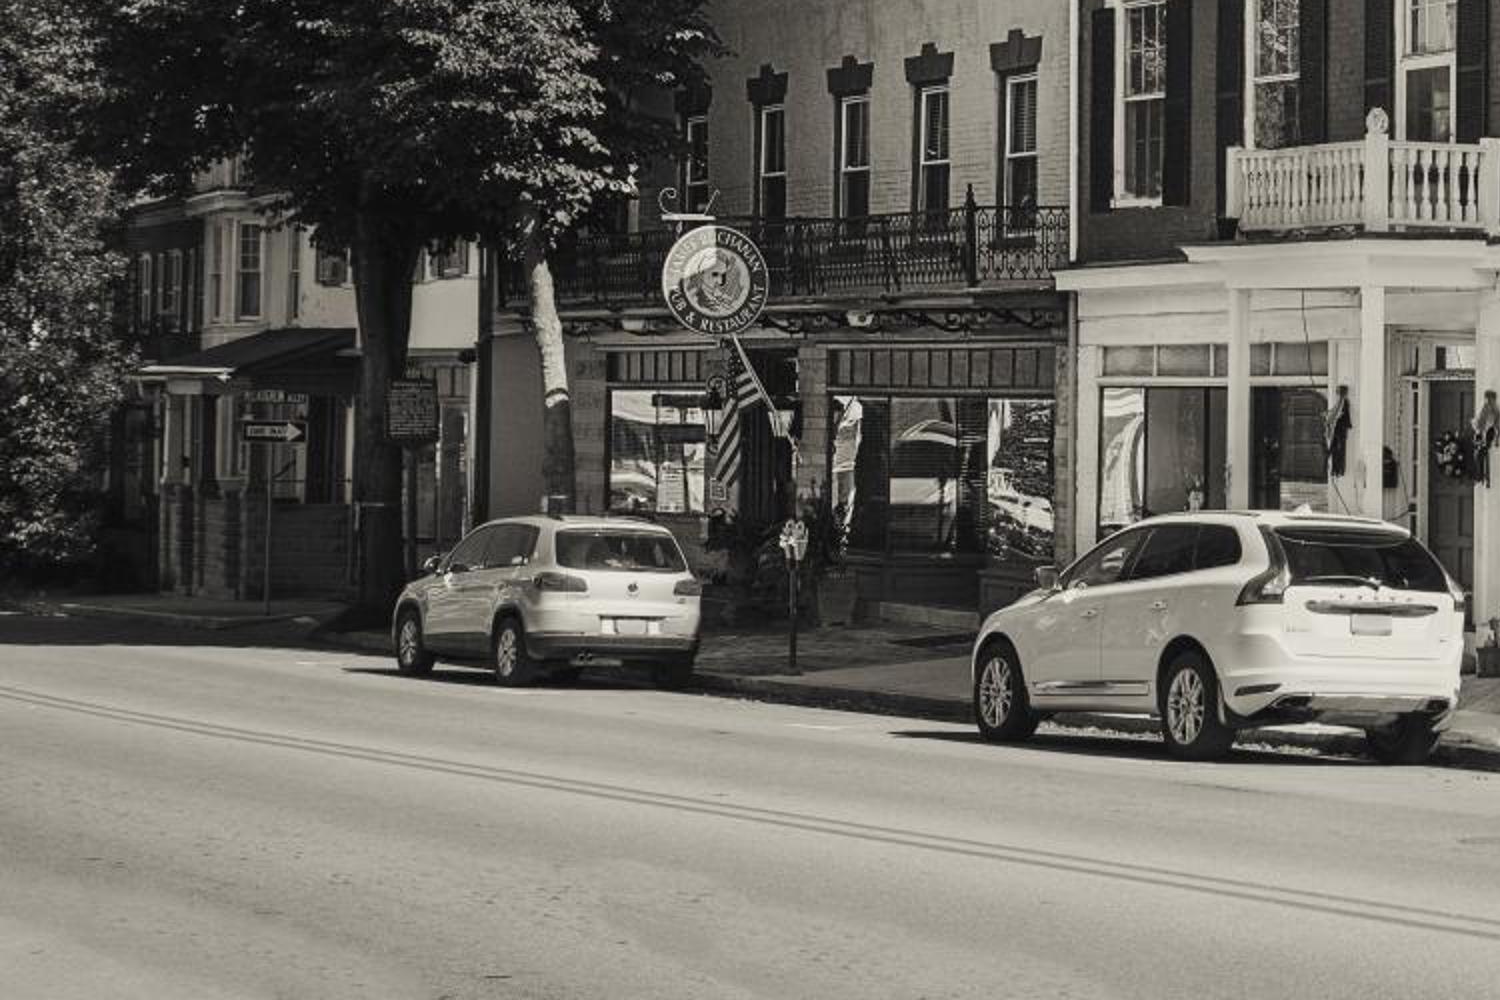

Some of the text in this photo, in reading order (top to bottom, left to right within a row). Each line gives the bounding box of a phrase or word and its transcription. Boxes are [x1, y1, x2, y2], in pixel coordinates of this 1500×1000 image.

[701, 230, 762, 272] CHANAN
[670, 283, 765, 332] PUB & RESTAURANT
